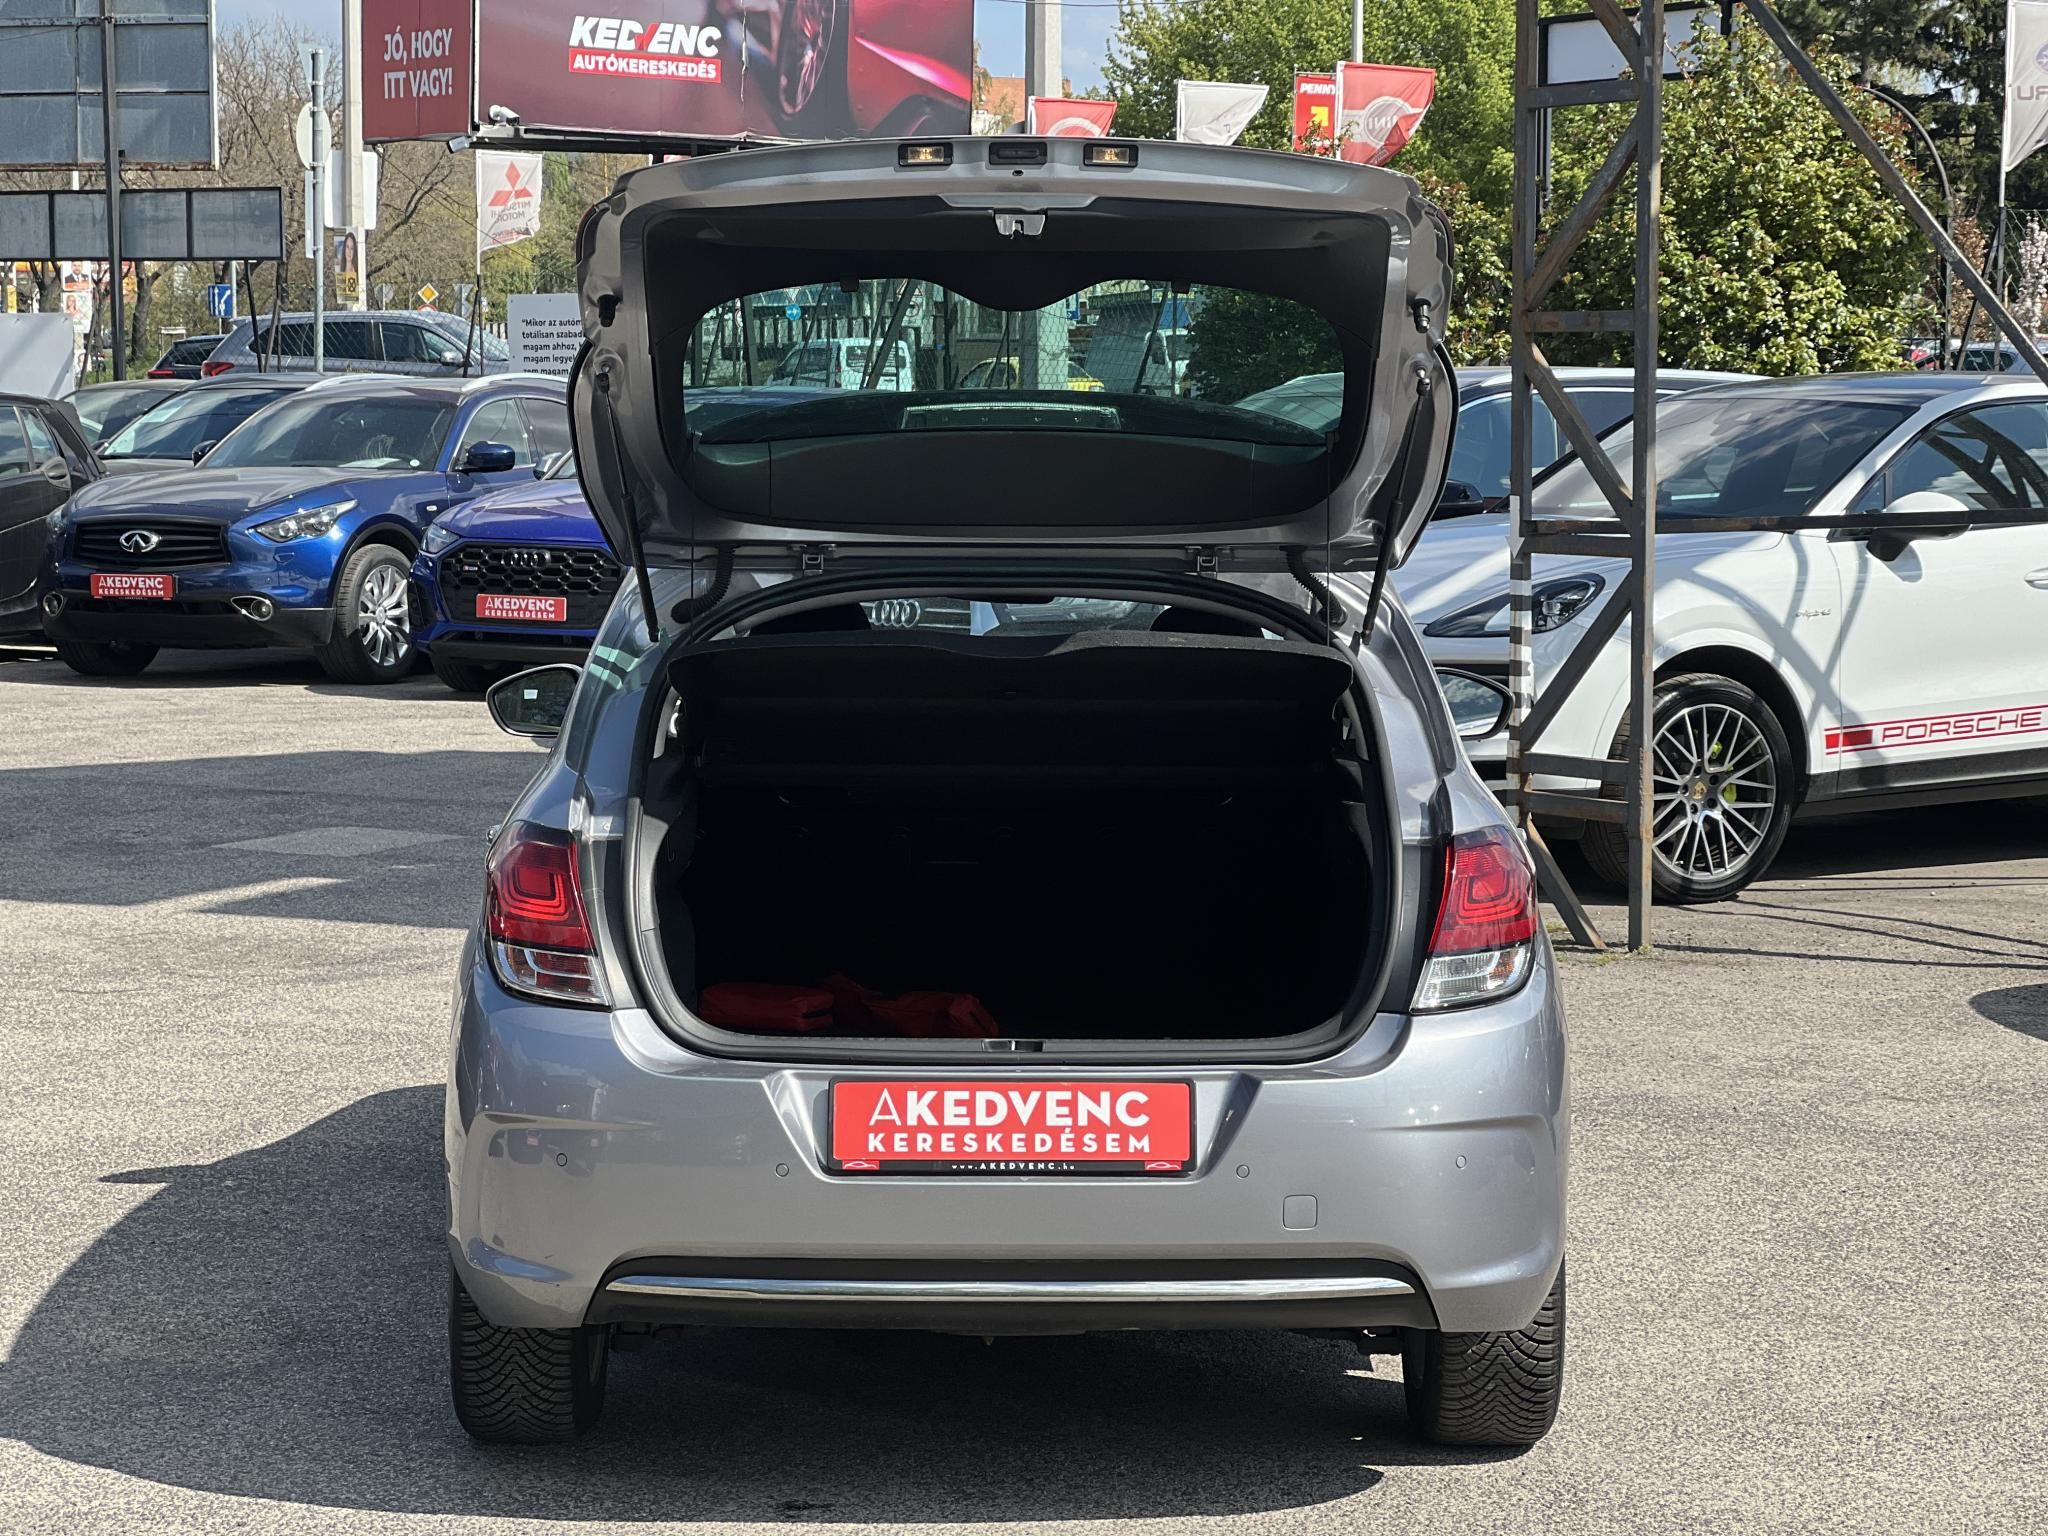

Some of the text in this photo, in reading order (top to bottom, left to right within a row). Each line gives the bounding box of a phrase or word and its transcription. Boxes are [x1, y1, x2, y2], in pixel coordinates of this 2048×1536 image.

[383, 24, 453, 65] JÓ, HOGY
[573, 53, 717, 79] AUTÓKERESKEDÉS
[383, 66, 453, 99] ITT VAGY!
[548, 319, 557, 327] az
[523, 344, 550, 352] magam
[552, 341, 577, 351] ahhoz,
[523, 356, 550, 364] magam
[98, 576, 164, 589] AKEDVENC
[98, 587, 165, 596] KERESKEDÉSEM
[485, 596, 555, 611] AKEDVENC
[484, 608, 555, 619] KERESKEDÉSEM
[1881, 711, 2042, 743] PORSCHE
[868, 1088, 1151, 1128] AKEDVENC
[867, 1127, 1151, 1154] KERESKEDÉSEM
[951, 1162, 1076, 1171] www.AKEDVENC.hu
